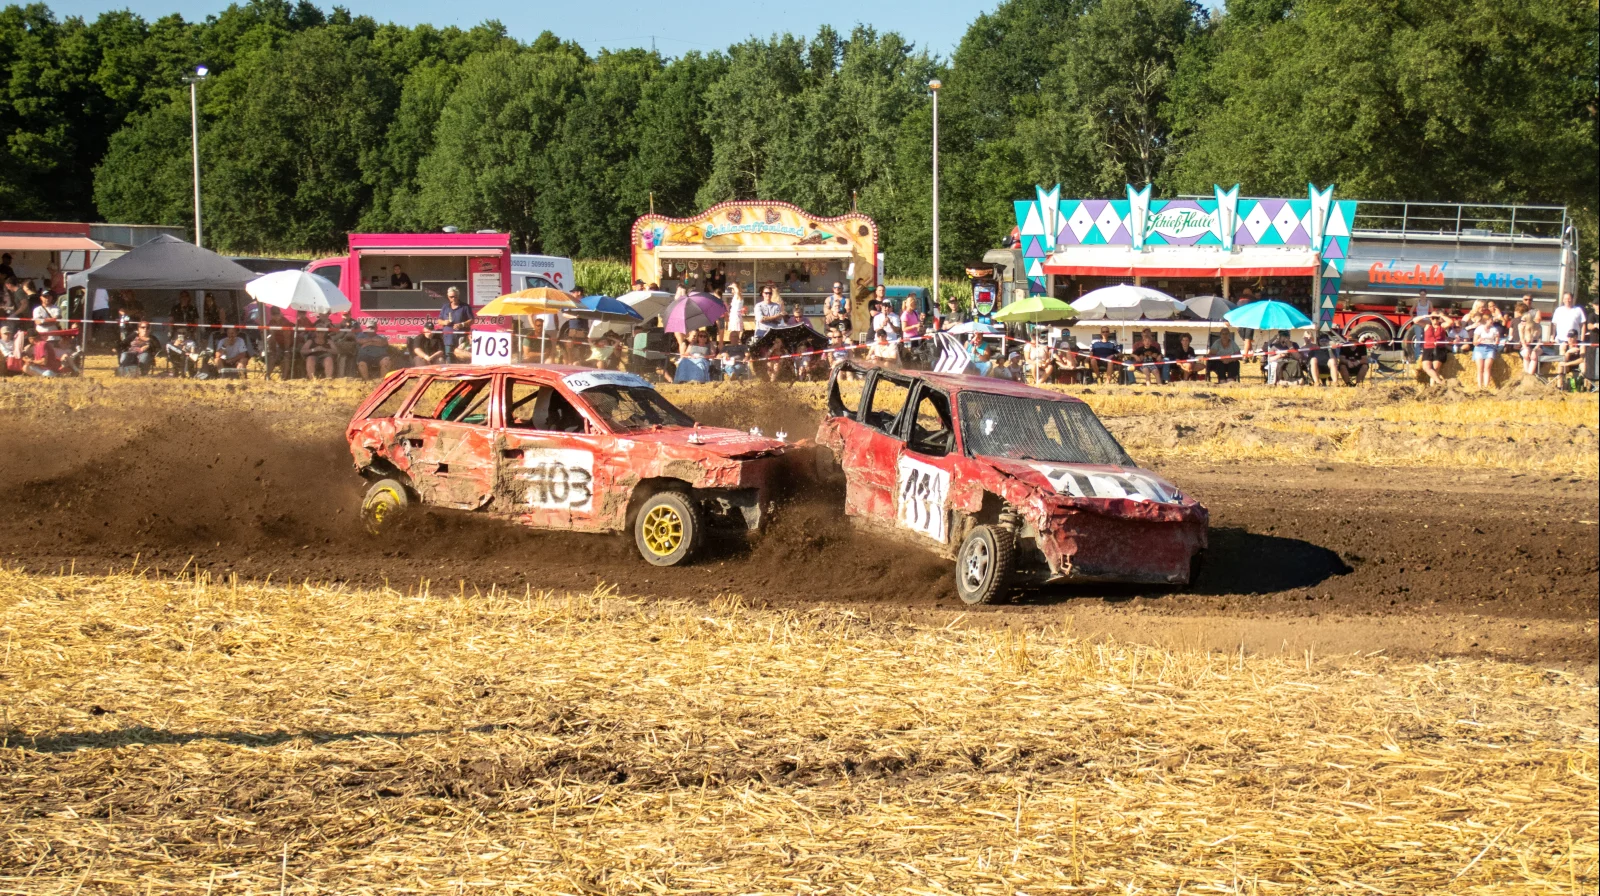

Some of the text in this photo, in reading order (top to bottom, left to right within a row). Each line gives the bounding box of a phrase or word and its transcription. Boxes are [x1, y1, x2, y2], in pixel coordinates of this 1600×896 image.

[705, 221, 805, 239] Schlaraffenland
[1474, 272, 1542, 290] Milch
[473, 336, 509, 358] 103
[567, 379, 591, 387] 103
[526, 462, 593, 507] 103
